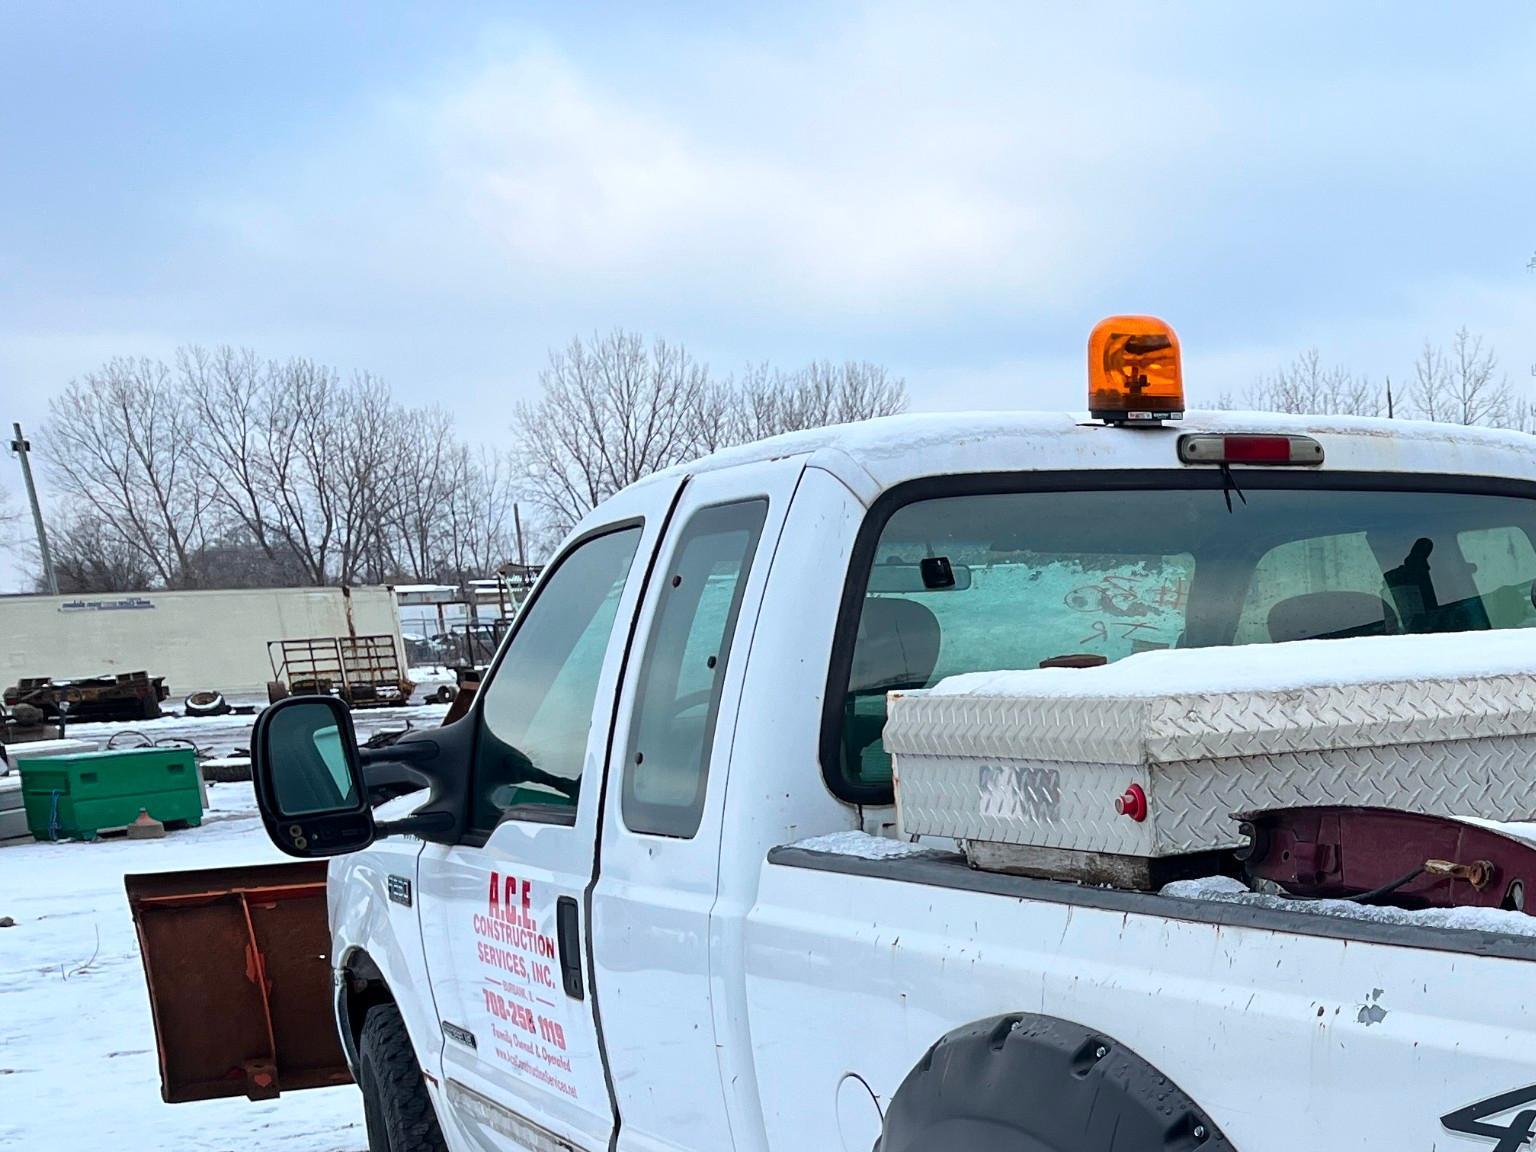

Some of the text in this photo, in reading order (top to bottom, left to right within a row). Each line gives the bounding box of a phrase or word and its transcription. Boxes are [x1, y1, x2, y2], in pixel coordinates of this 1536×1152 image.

[489, 871, 536, 932] A.C.E.
[473, 913, 555, 959] CONSTRUCTION
[478, 940, 556, 989] SERVICES, INC.
[538, 1014, 566, 1050] 1119
